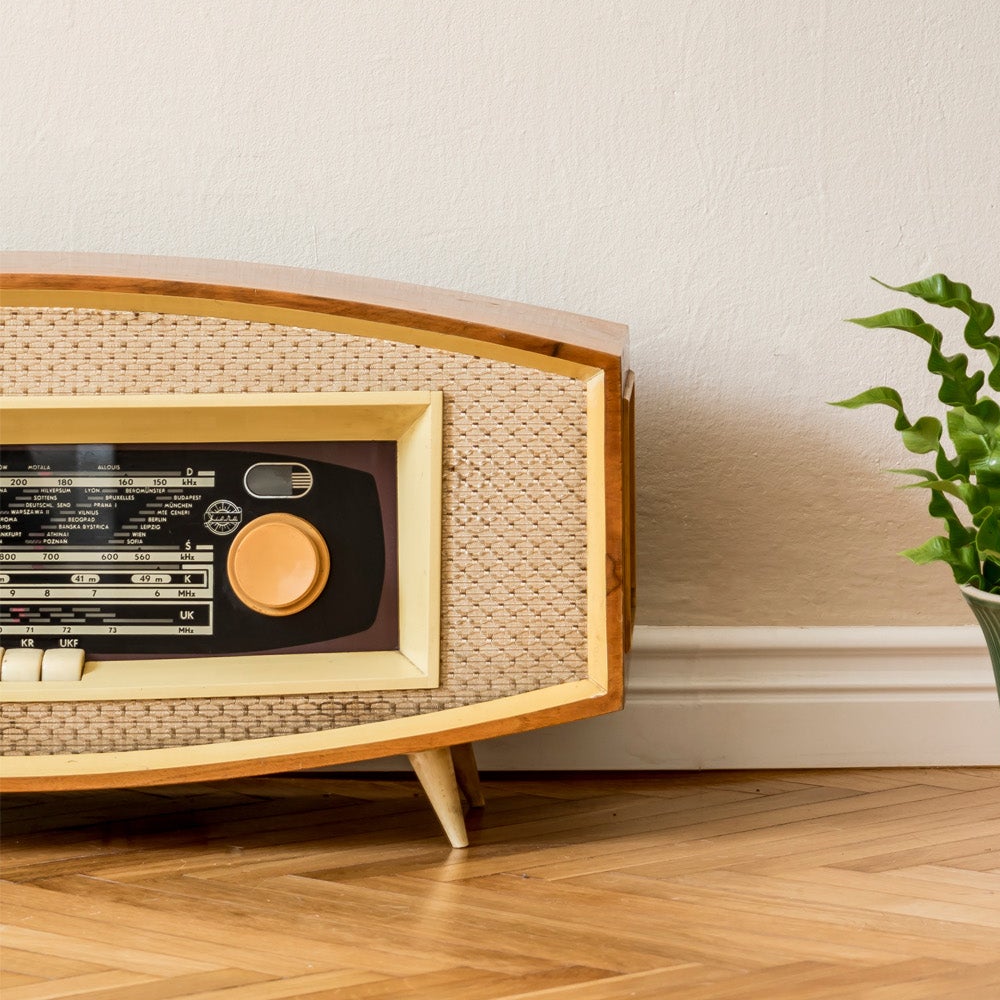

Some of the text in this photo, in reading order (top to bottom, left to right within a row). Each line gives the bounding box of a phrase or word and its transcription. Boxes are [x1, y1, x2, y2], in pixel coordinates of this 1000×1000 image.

[186, 468, 194, 476] D
[184, 575, 191, 583] K
[180, 610, 194, 620] UK
[21, 639, 34, 648] KR
[60, 639, 78, 648] UKF
